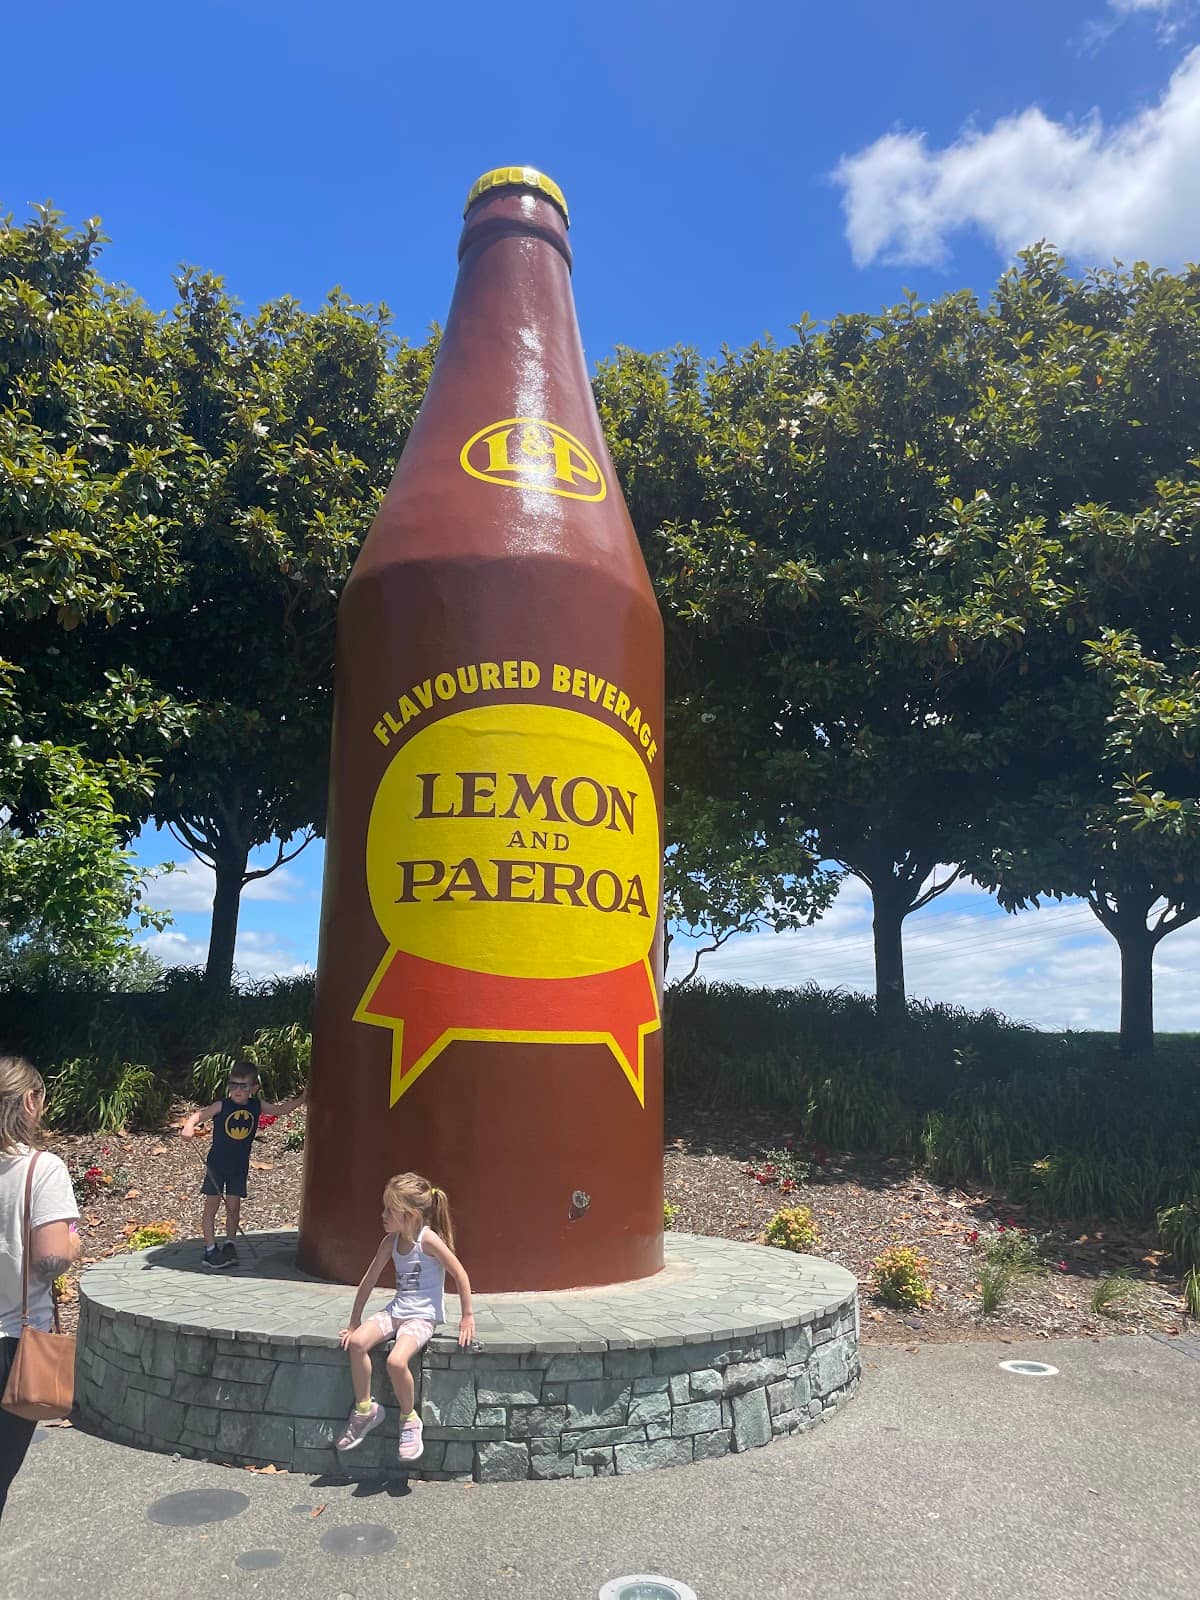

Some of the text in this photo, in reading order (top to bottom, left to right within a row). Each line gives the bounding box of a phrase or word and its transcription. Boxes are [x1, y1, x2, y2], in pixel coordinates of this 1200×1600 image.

[482, 426, 599, 486] L&P
[372, 660, 659, 764] FLAVOURED BEVERAGE
[414, 772, 638, 835] LEMON
[506, 830, 570, 851] AND
[394, 857, 651, 918] PAEROA
